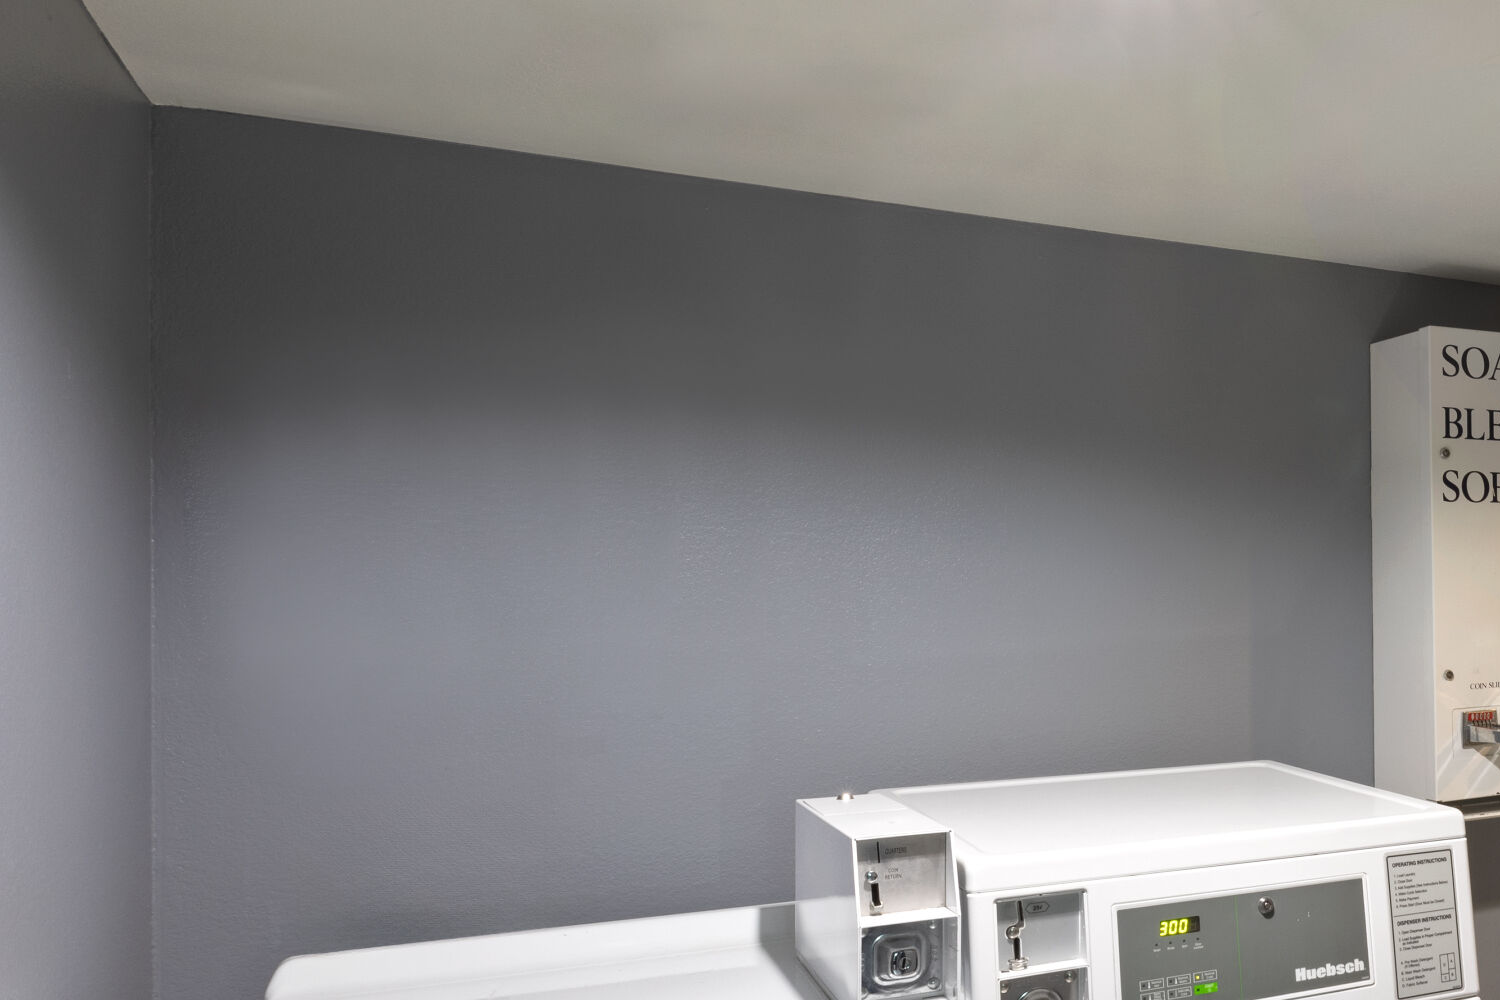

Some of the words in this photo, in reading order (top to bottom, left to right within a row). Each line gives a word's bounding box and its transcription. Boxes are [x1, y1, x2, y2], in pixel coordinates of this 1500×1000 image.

[1470, 682, 1487, 690] COIN
[1417, 857, 1447, 865] INSTRUCTIONS
[1422, 914, 1452, 922] INSTRUCTIONS
[1160, 918, 1188, 937] 300
[1295, 958, 1365, 982] Huebsch
